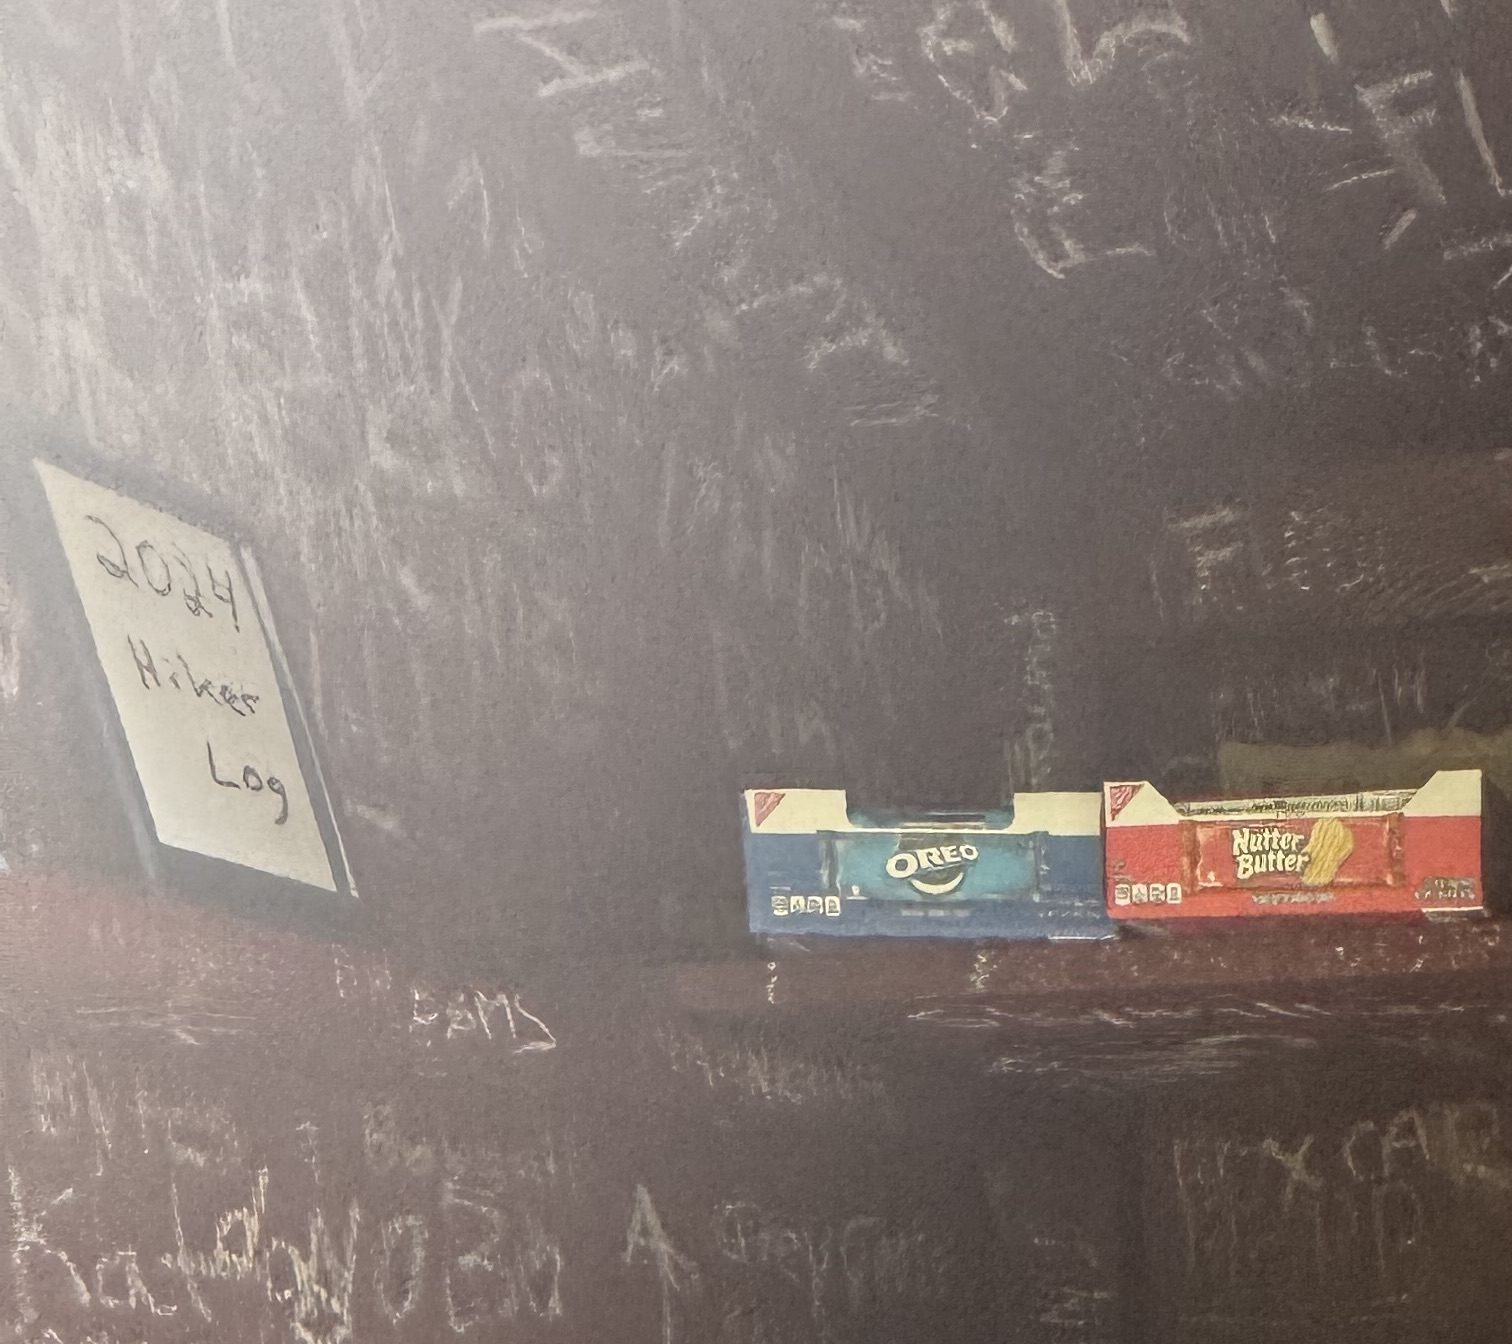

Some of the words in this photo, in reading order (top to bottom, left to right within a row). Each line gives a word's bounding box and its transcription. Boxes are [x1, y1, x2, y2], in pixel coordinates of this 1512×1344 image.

[84, 513, 241, 634] 2024
[127, 633, 260, 717] Hiker
[206, 740, 290, 826] Log
[885, 844, 979, 879] OREO
[1231, 828, 1305, 857] Nutter
[1236, 851, 1310, 880] Butter
